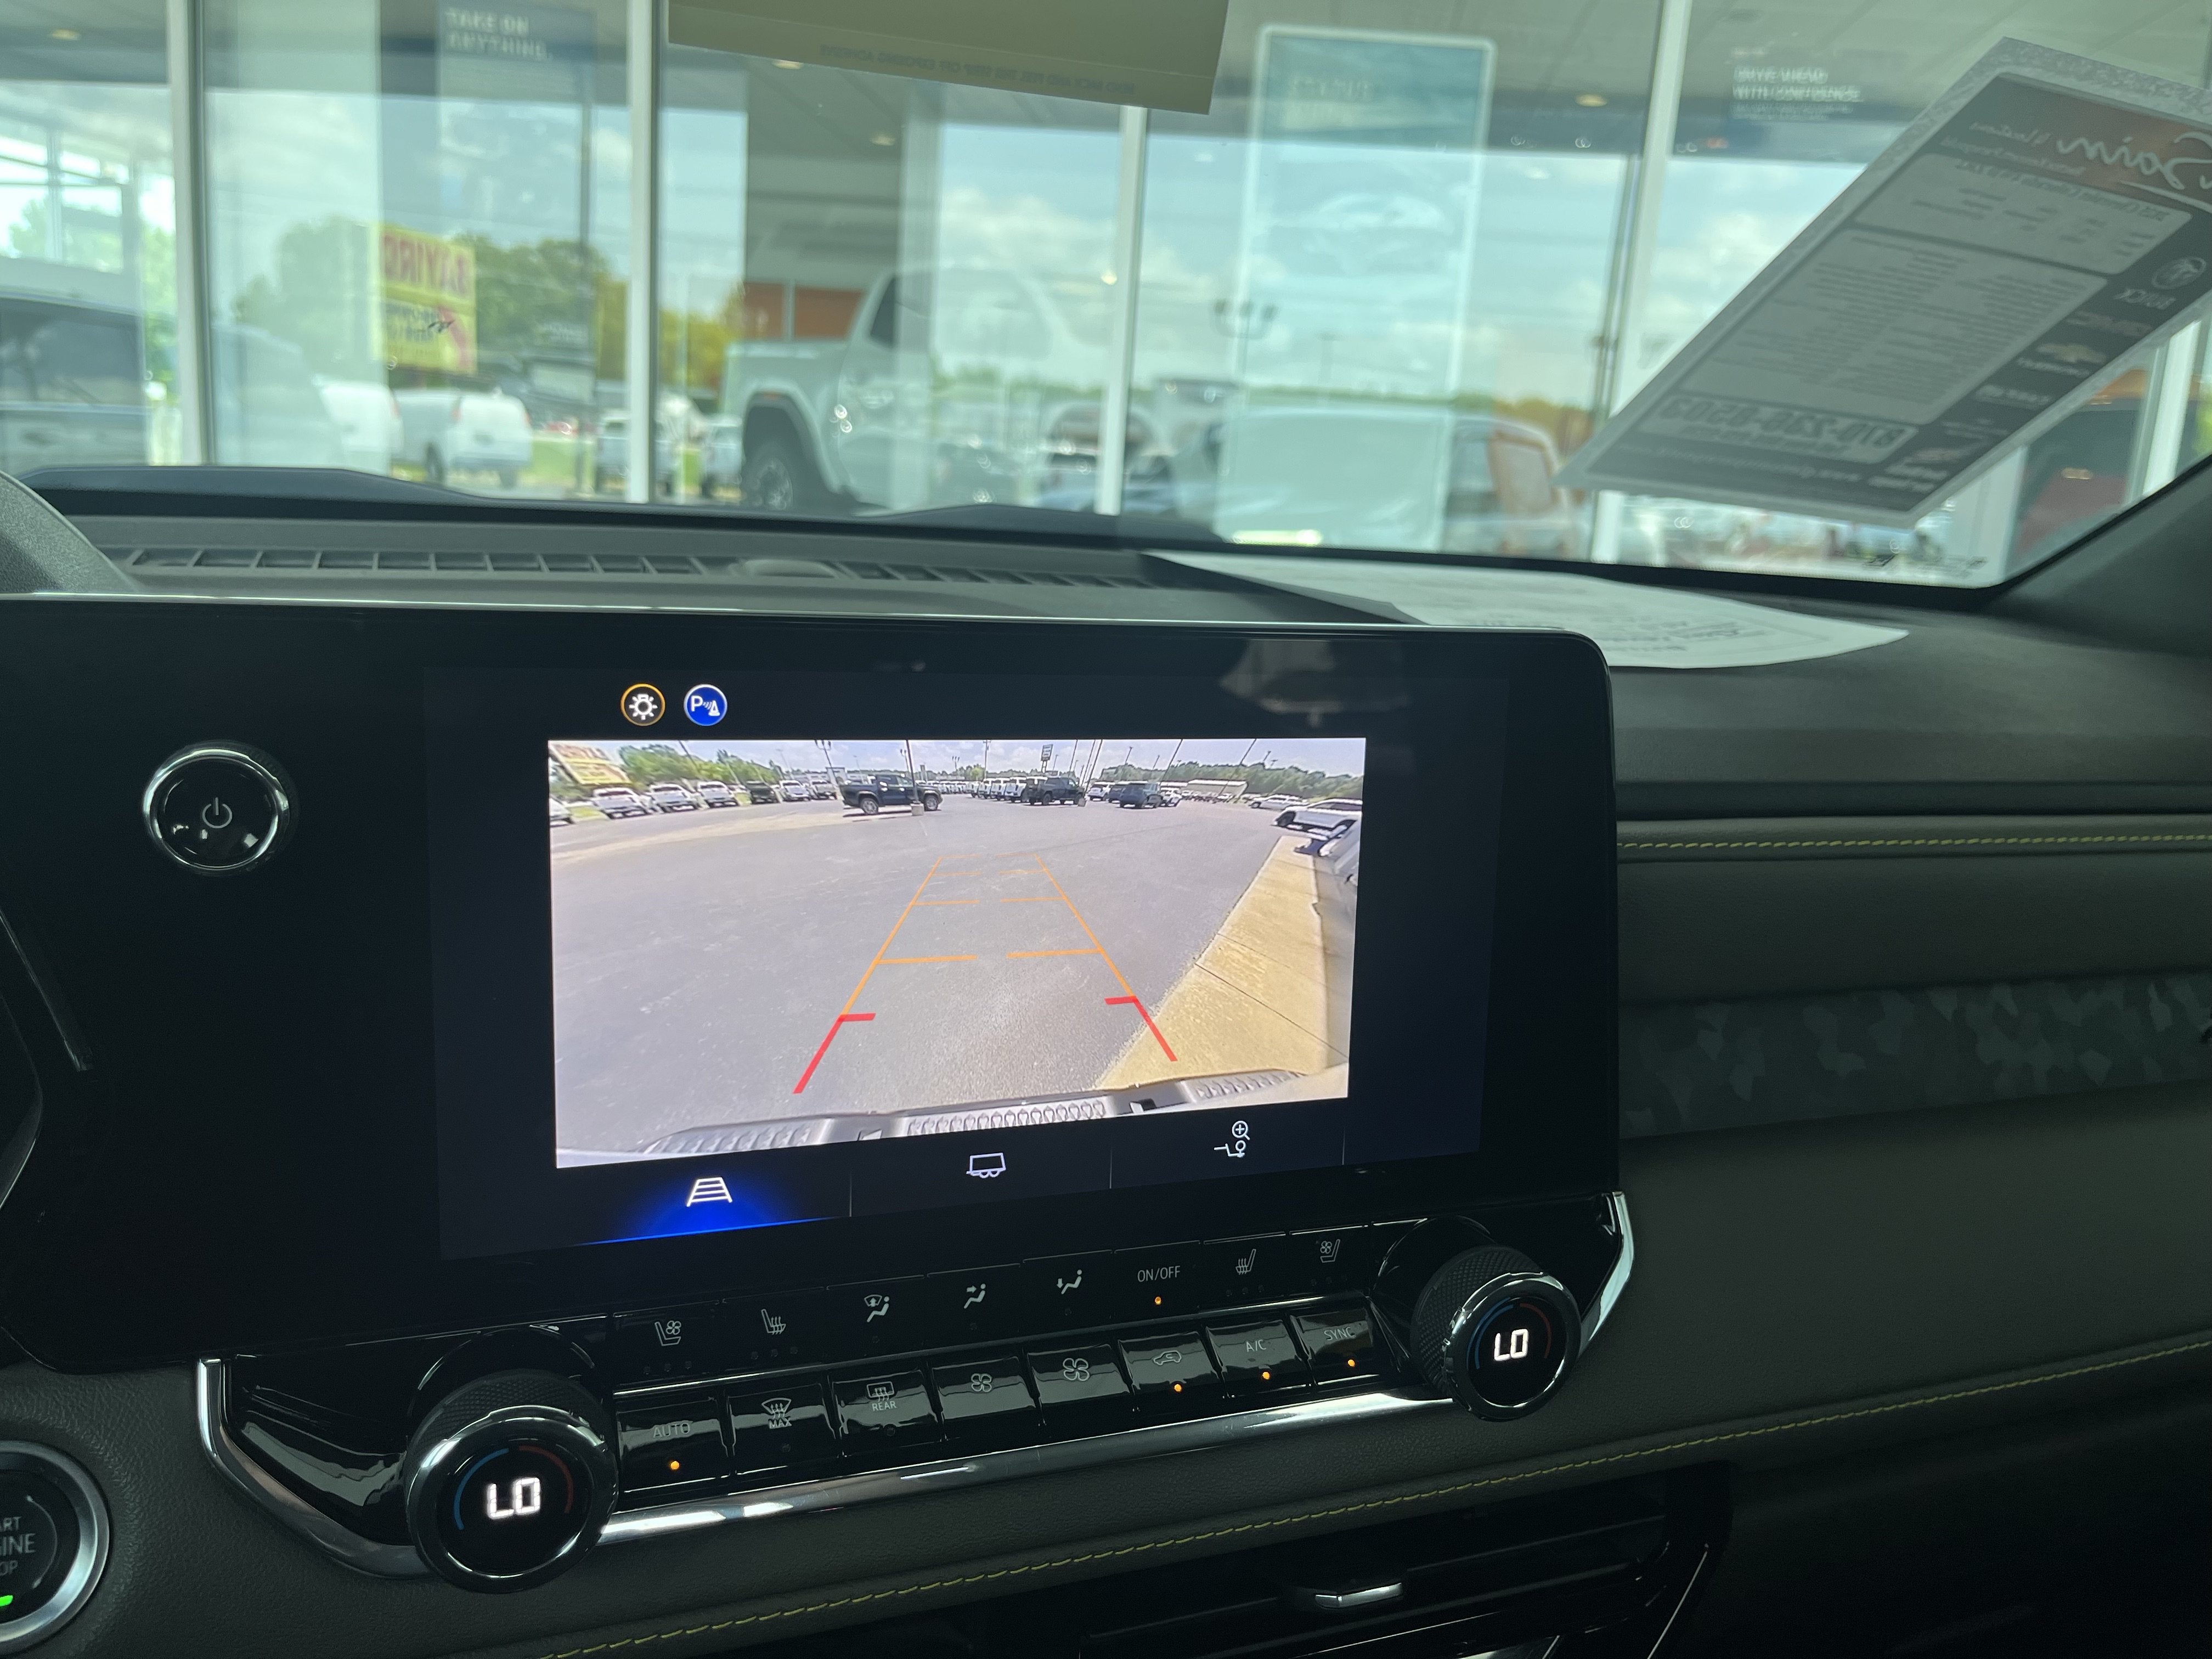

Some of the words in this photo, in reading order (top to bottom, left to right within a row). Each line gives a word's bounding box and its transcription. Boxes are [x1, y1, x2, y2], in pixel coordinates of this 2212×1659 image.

[447, 8, 495, 32] TAKE
[500, 14, 530, 37] ON
[447, 31, 547, 60] ANYTHING
[1137, 1266, 1181, 1283] ON/OFF
[1323, 1325, 1356, 1342] SYNC
[1246, 1339, 1267, 1353] A/C
[1493, 1328, 1529, 1362] LO
[872, 1402, 898, 1412] REAR
[653, 1422, 691, 1438] AUTO
[769, 1418, 792, 1429] MAX
[487, 1476, 541, 1520] LO
[0, 1516, 22, 1531] RT
[0, 1533, 36, 1556] INE
